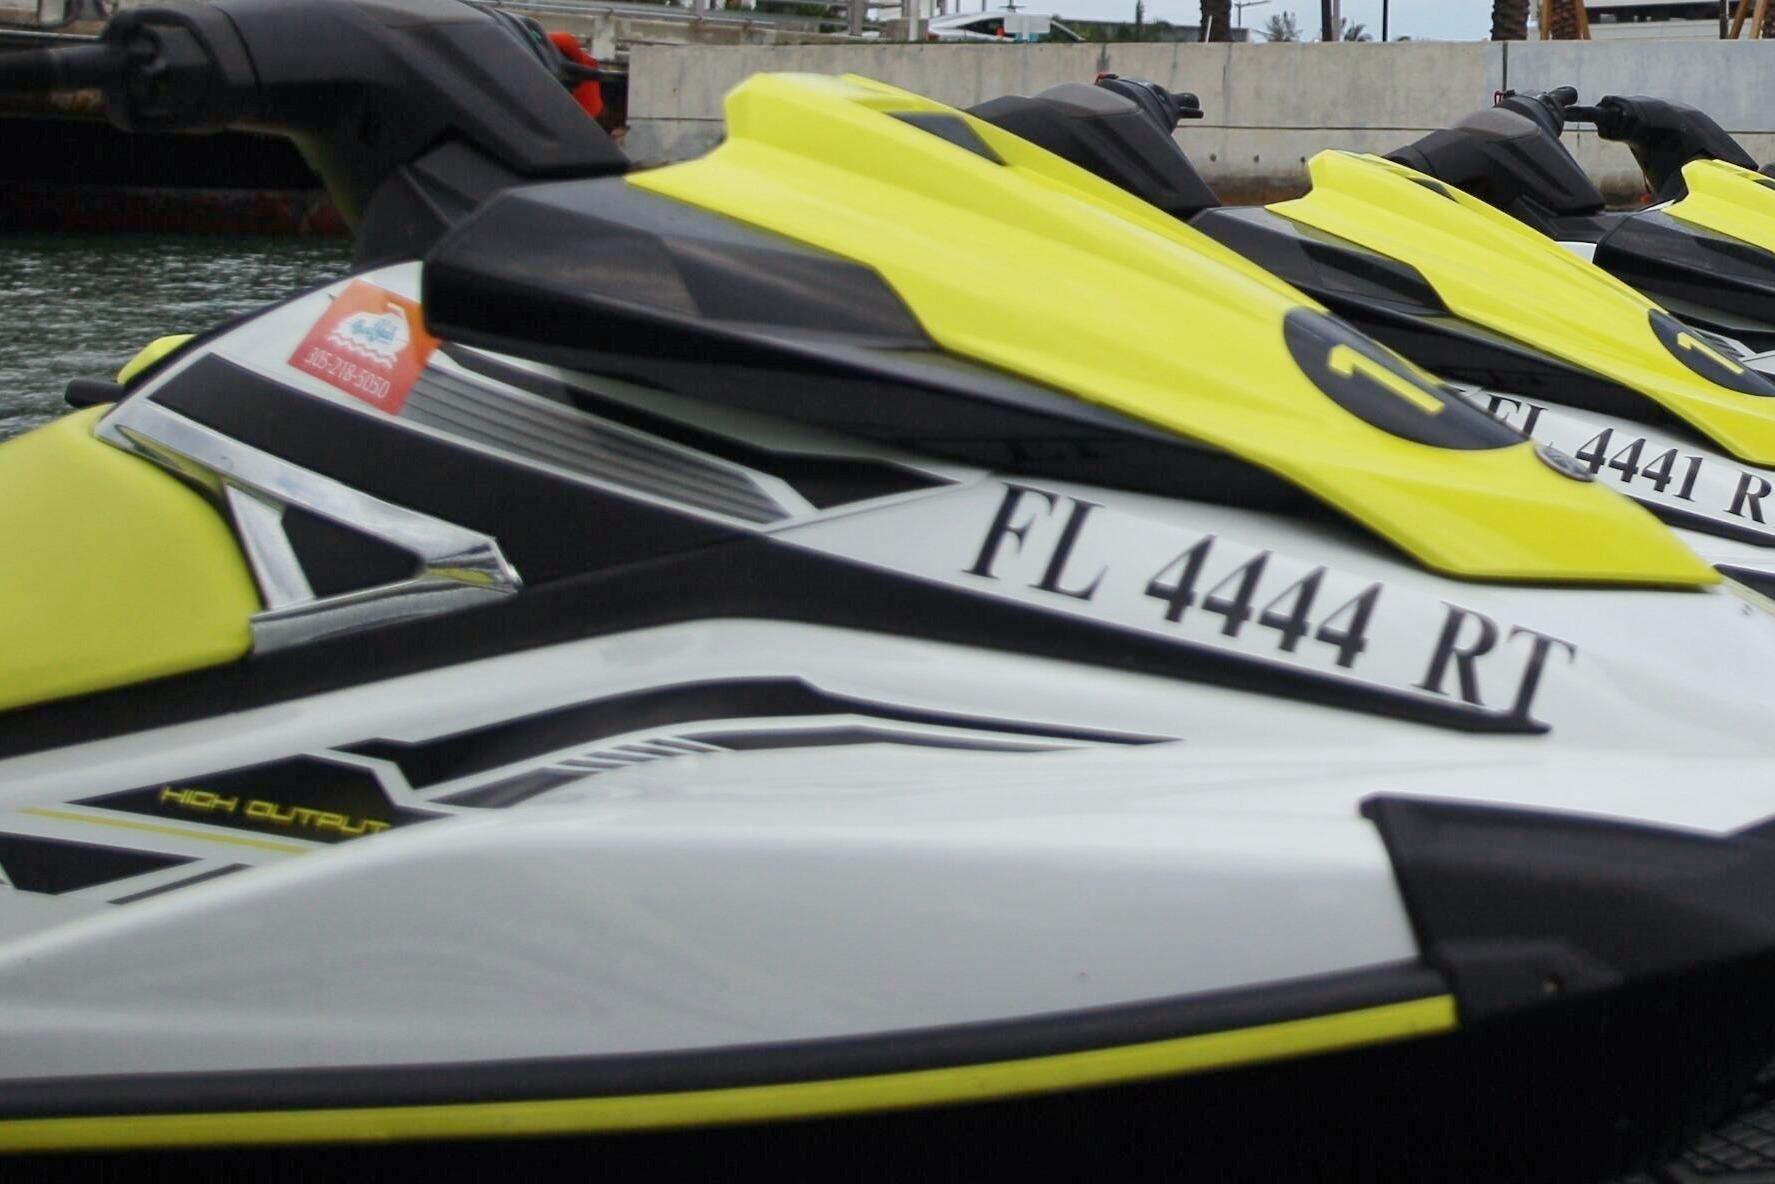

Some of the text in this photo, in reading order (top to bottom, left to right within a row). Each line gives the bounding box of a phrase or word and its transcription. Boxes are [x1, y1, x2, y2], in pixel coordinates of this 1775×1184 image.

[1328, 343, 1446, 419] 1
[1575, 426, 1704, 503] 4441
[962, 481, 1579, 728] FL 4444 RT
[160, 786, 393, 838] HIGH OUTPUT
